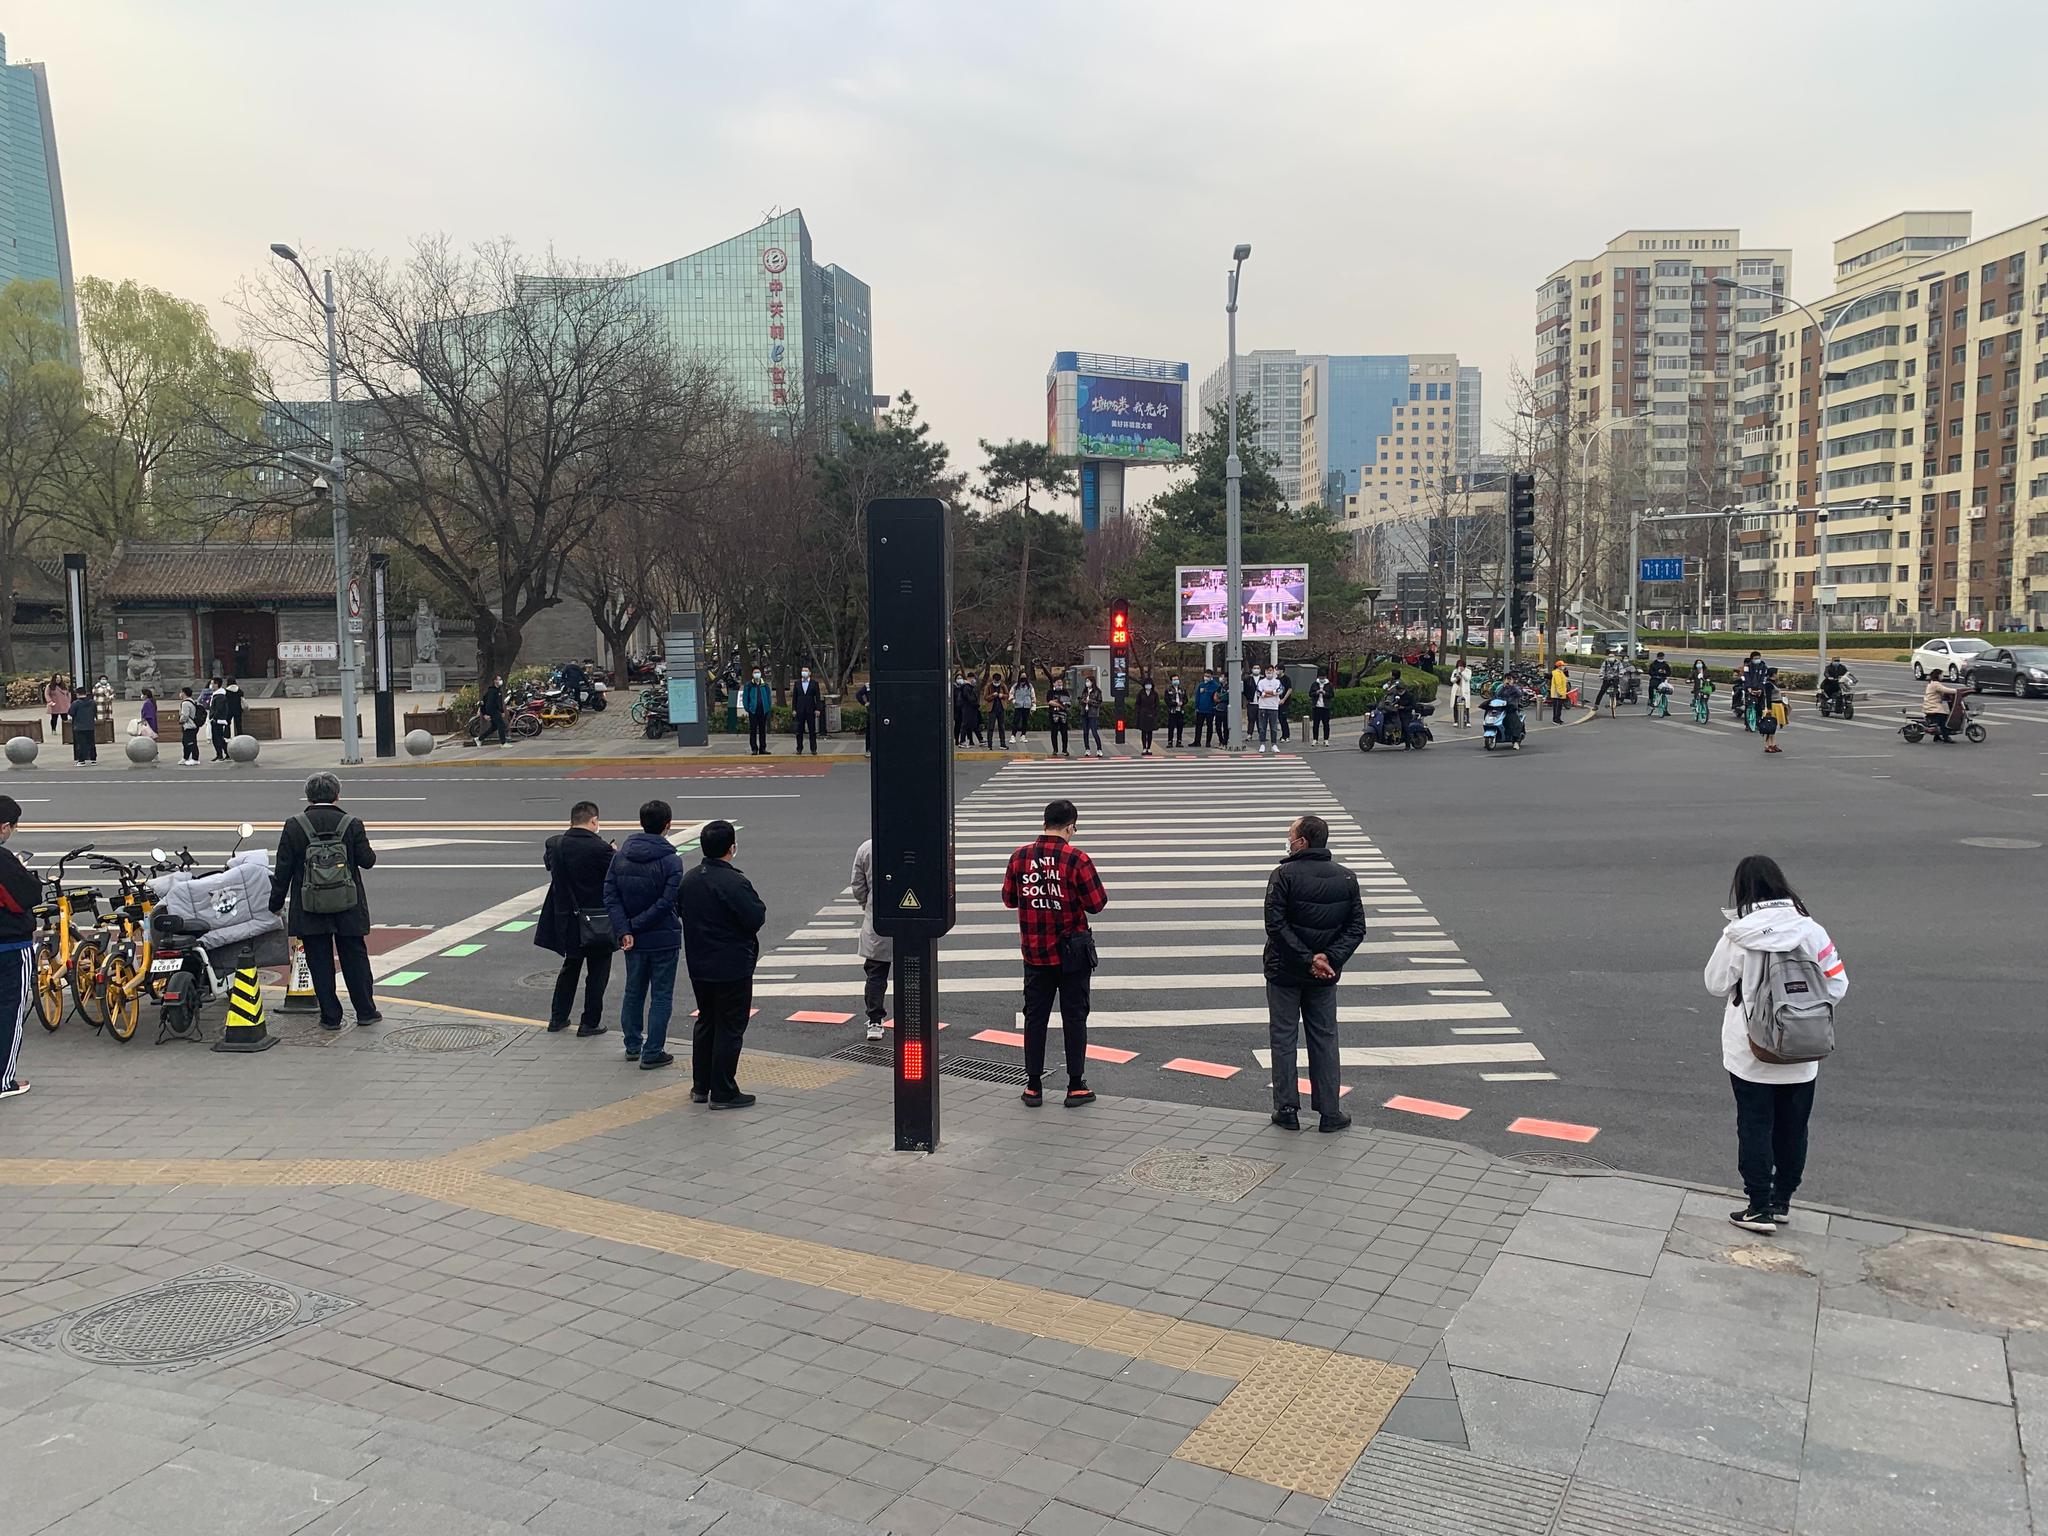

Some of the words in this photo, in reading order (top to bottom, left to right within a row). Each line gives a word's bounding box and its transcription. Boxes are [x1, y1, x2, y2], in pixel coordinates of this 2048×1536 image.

[1133, 401, 1169, 418] 我先行
[1113, 631, 1126, 643] 28
[1030, 856, 1055, 870] ANTI
[1022, 883, 1064, 898] SOCIAL
[1031, 898, 1062, 911] CLUB
